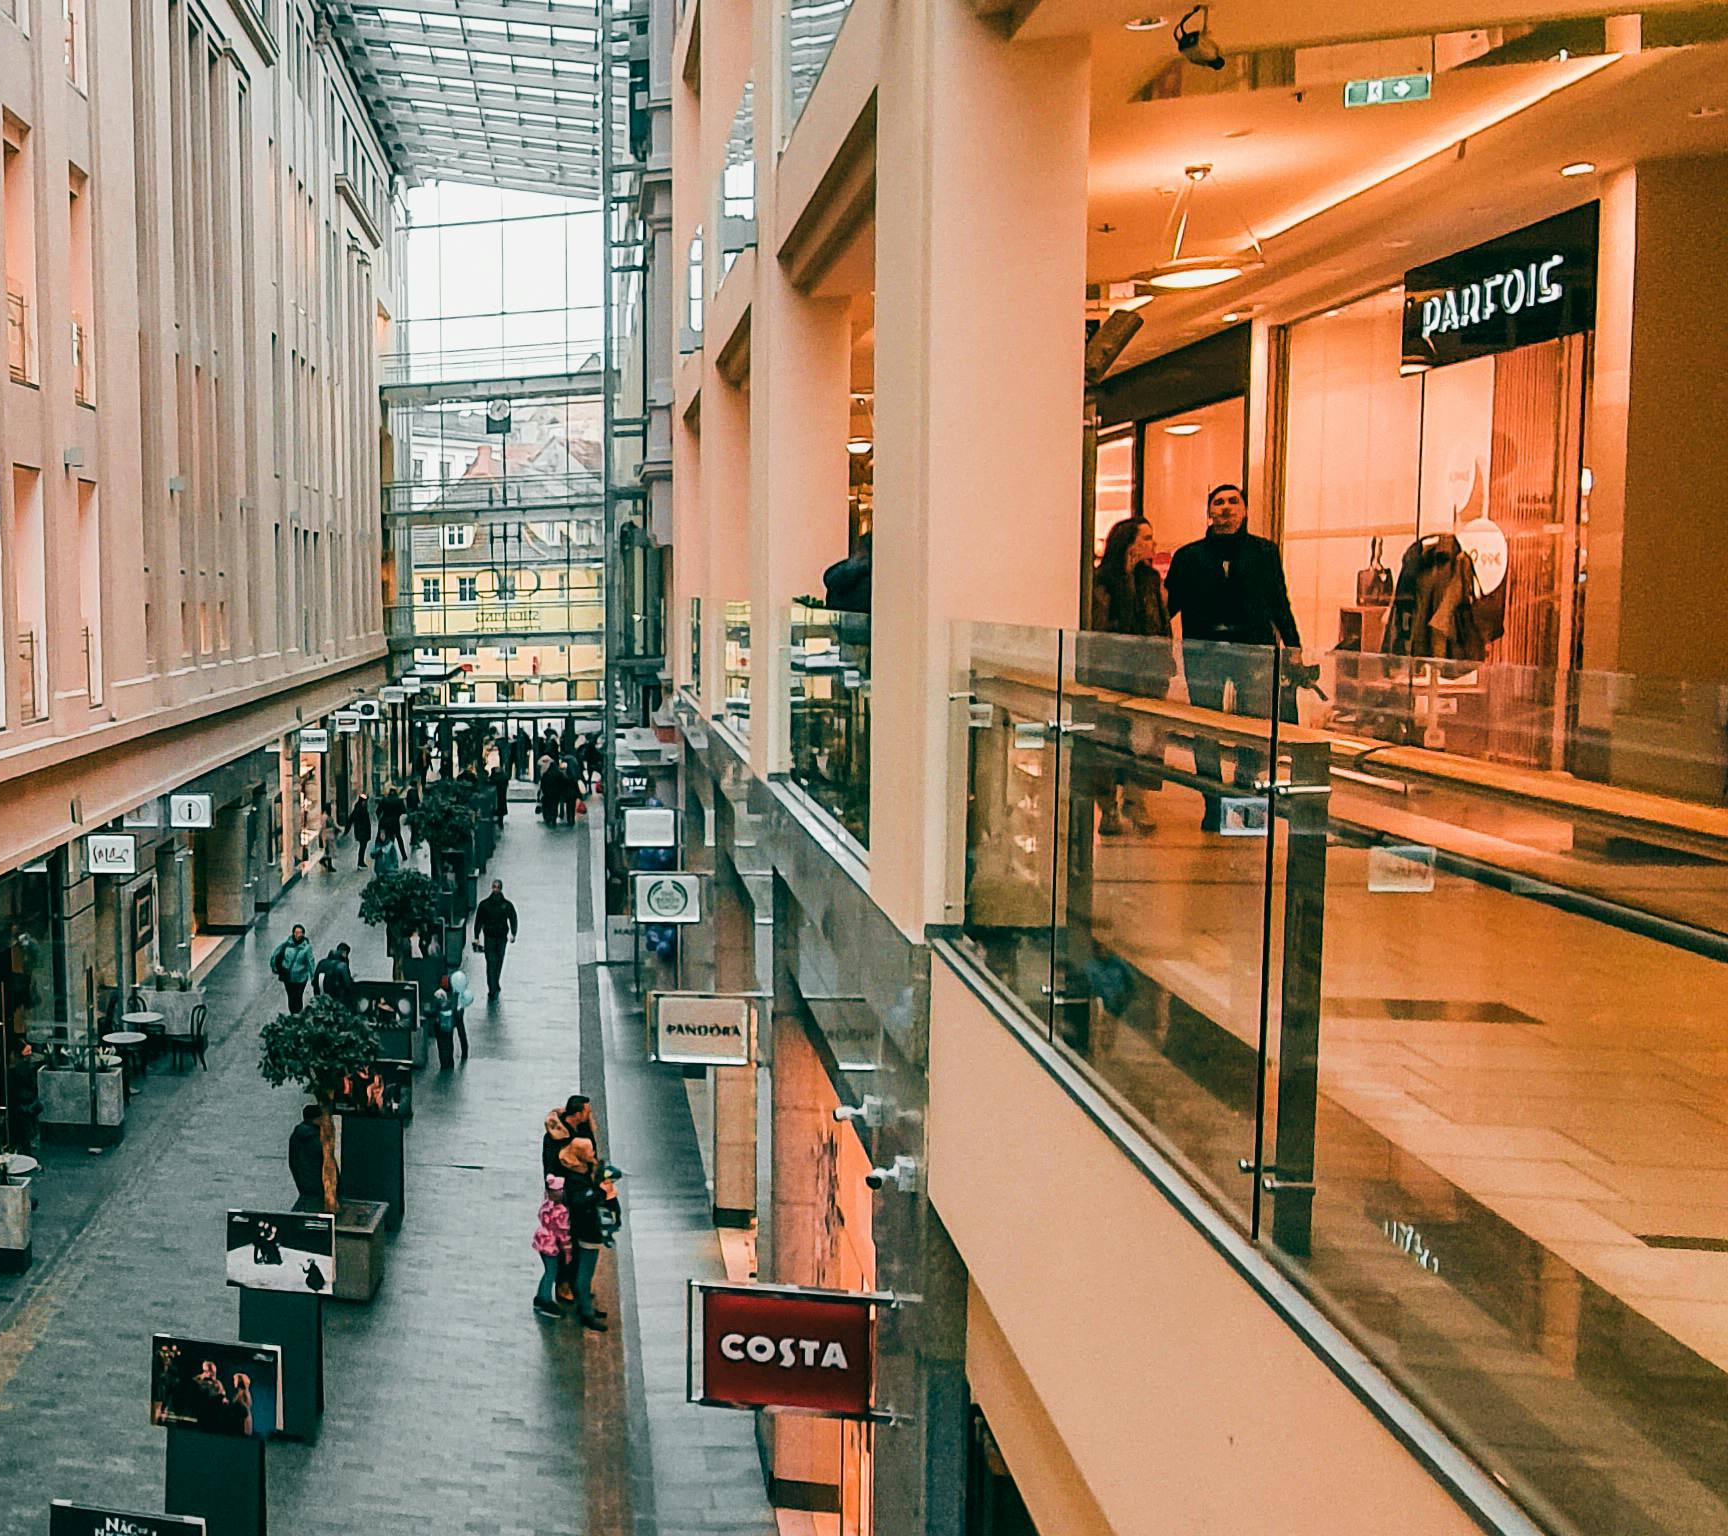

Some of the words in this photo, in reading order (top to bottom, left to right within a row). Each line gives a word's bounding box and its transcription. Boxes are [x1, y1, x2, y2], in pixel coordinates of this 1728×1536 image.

[1422, 254, 1564, 338] PARFOIS
[666, 1023, 741, 1037] PANDORA
[721, 1333, 848, 1369] COSTA
